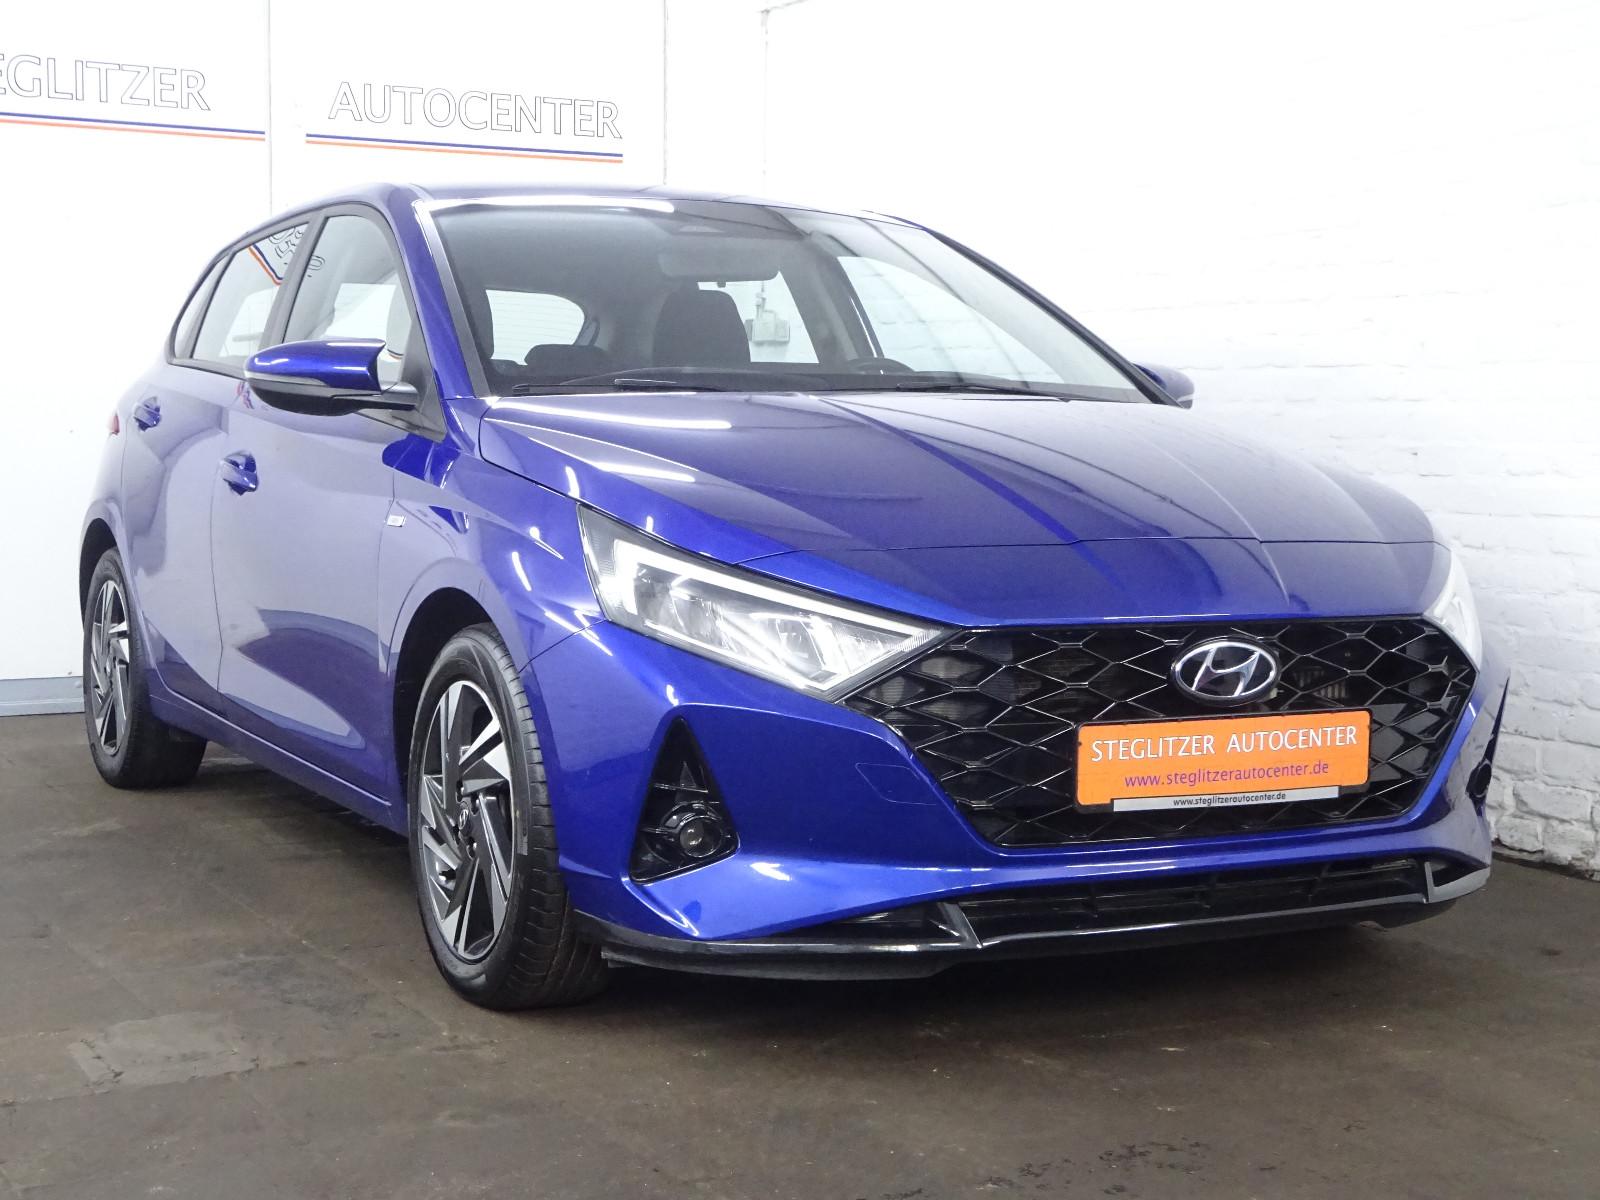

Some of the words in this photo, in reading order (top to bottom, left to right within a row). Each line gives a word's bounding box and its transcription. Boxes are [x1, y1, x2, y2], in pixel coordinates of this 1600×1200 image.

[0, 53, 211, 112] GLITZER
[327, 81, 623, 140] AUTOCENTER
[1091, 734, 1216, 763] STEGLITZER
[1226, 725, 1358, 754] AUTOCENTER
[1124, 760, 1330, 788] www.steglitzerautocenter.de
[1173, 792, 1287, 806] www.steglitzerautocenter.de
